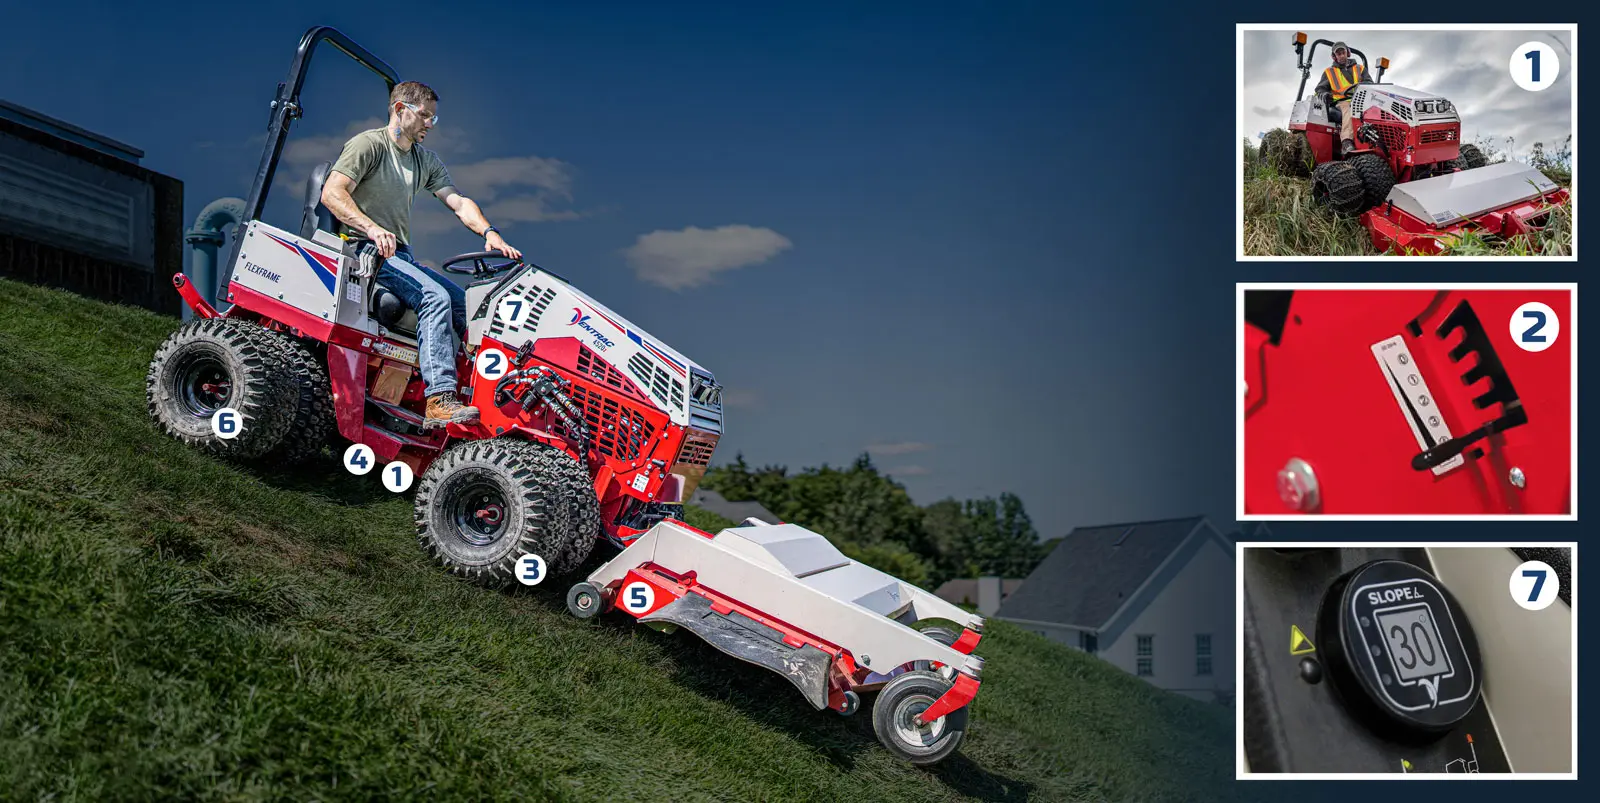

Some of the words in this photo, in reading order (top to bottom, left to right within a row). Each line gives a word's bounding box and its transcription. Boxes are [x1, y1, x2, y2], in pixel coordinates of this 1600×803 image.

[244, 261, 282, 284] FLEXFRAME
[566, 307, 615, 348] VENTRAC
[1368, 586, 1413, 605] SLOPE
